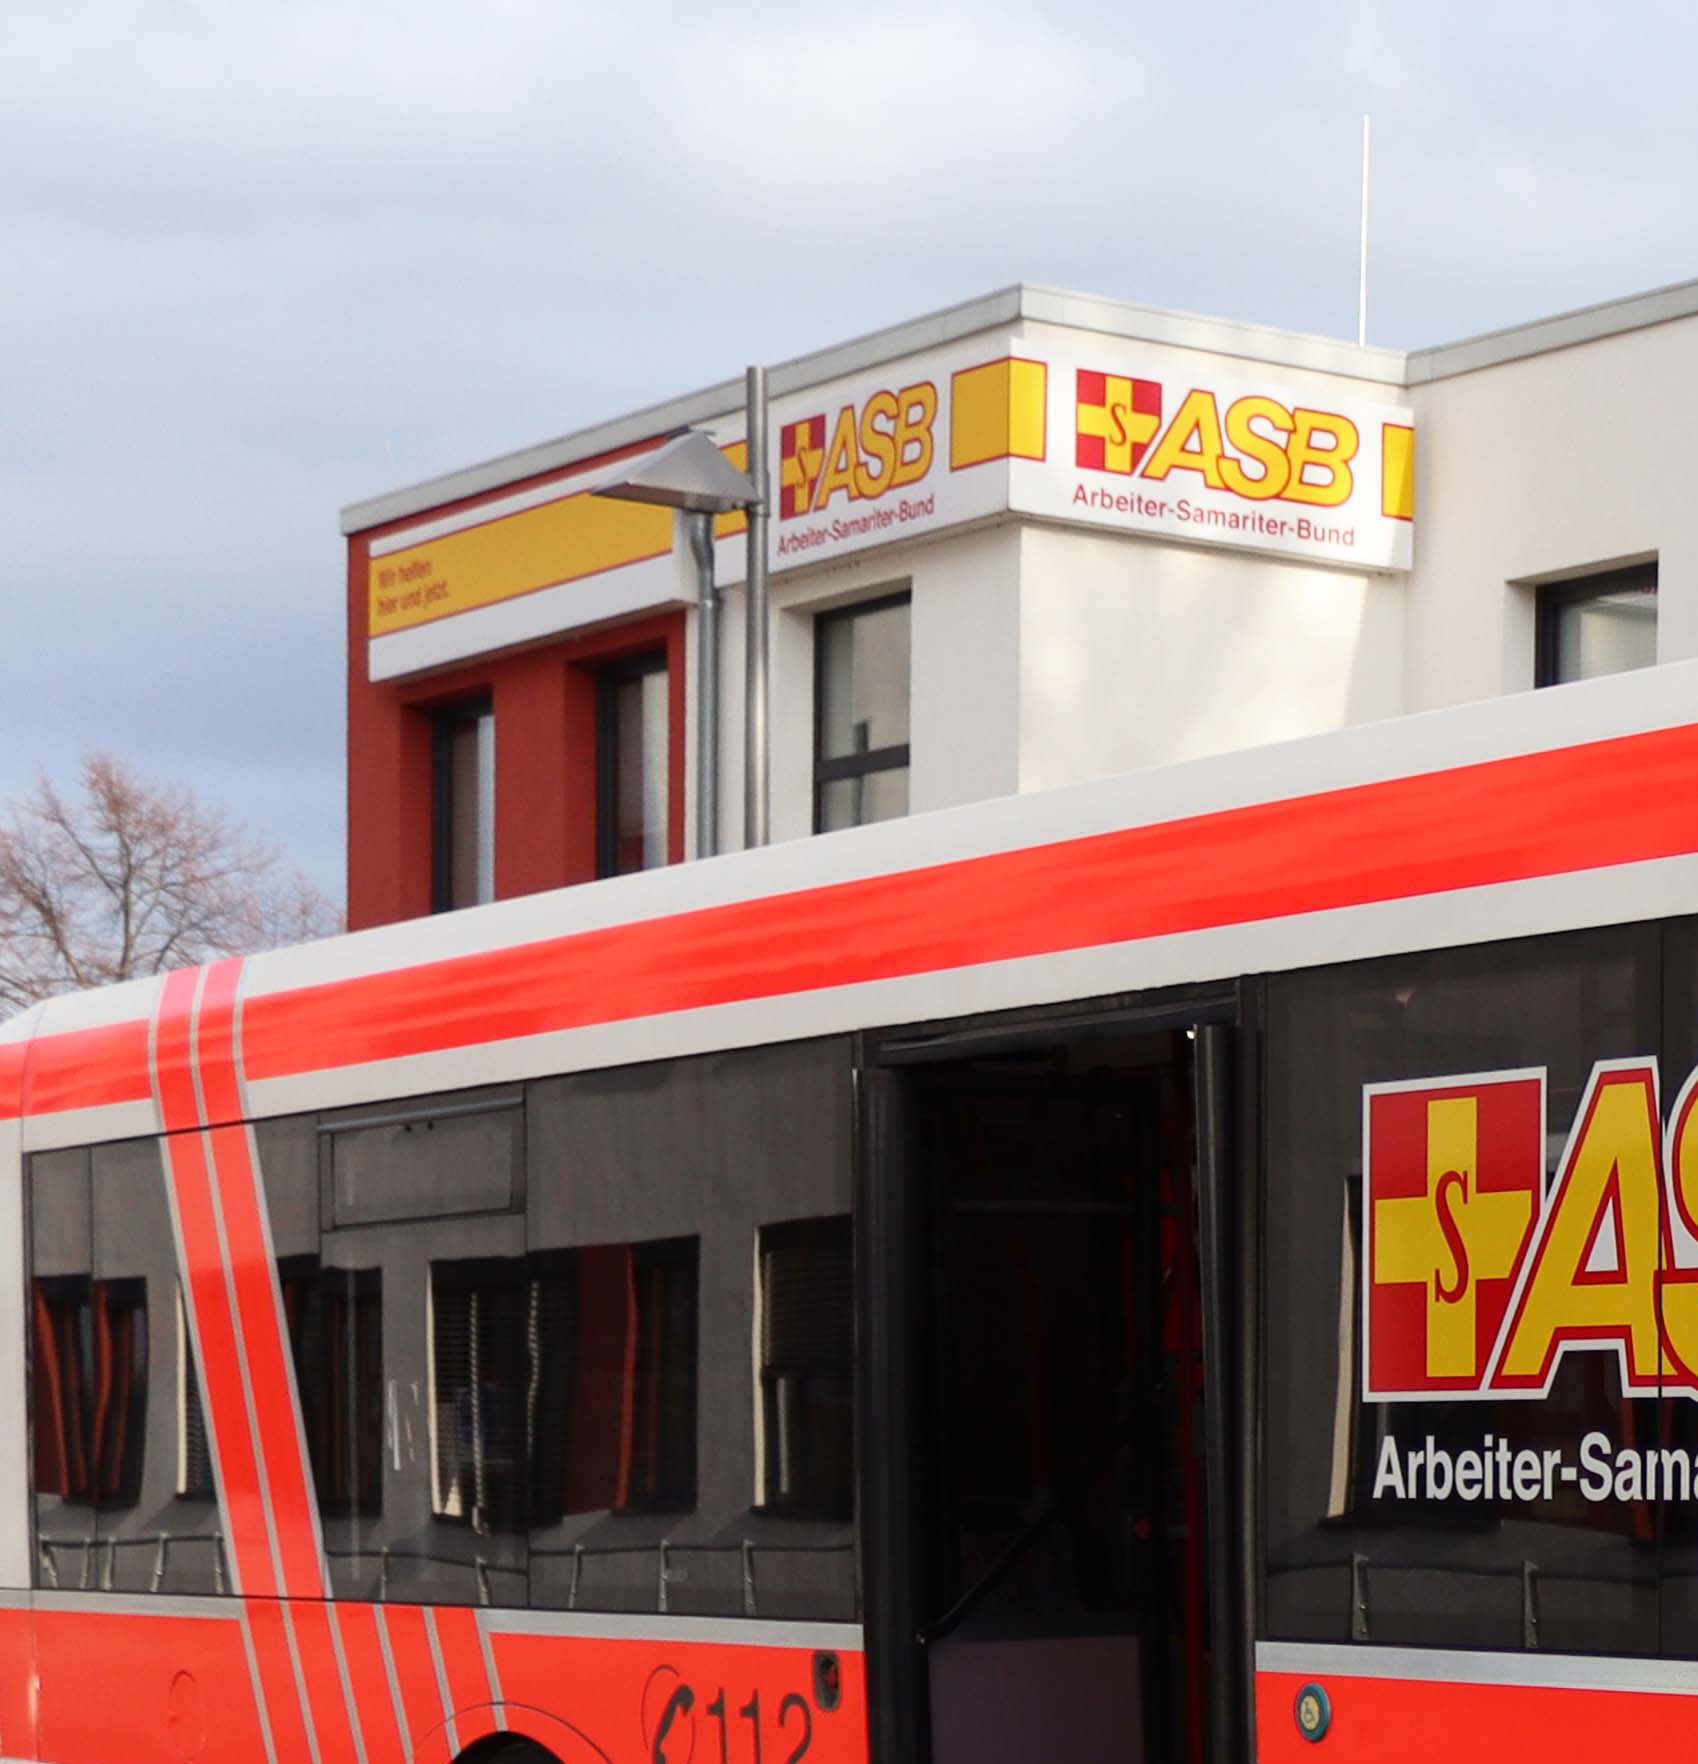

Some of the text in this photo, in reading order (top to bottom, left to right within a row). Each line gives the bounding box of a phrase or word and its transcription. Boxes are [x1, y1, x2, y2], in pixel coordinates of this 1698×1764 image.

[814, 381, 938, 513] ASB
[1140, 387, 1360, 508] ASB
[777, 493, 935, 556] Arbeiter-Samariter-Bund
[1073, 484, 1355, 546] Arbeiter-Samariter-Bund
